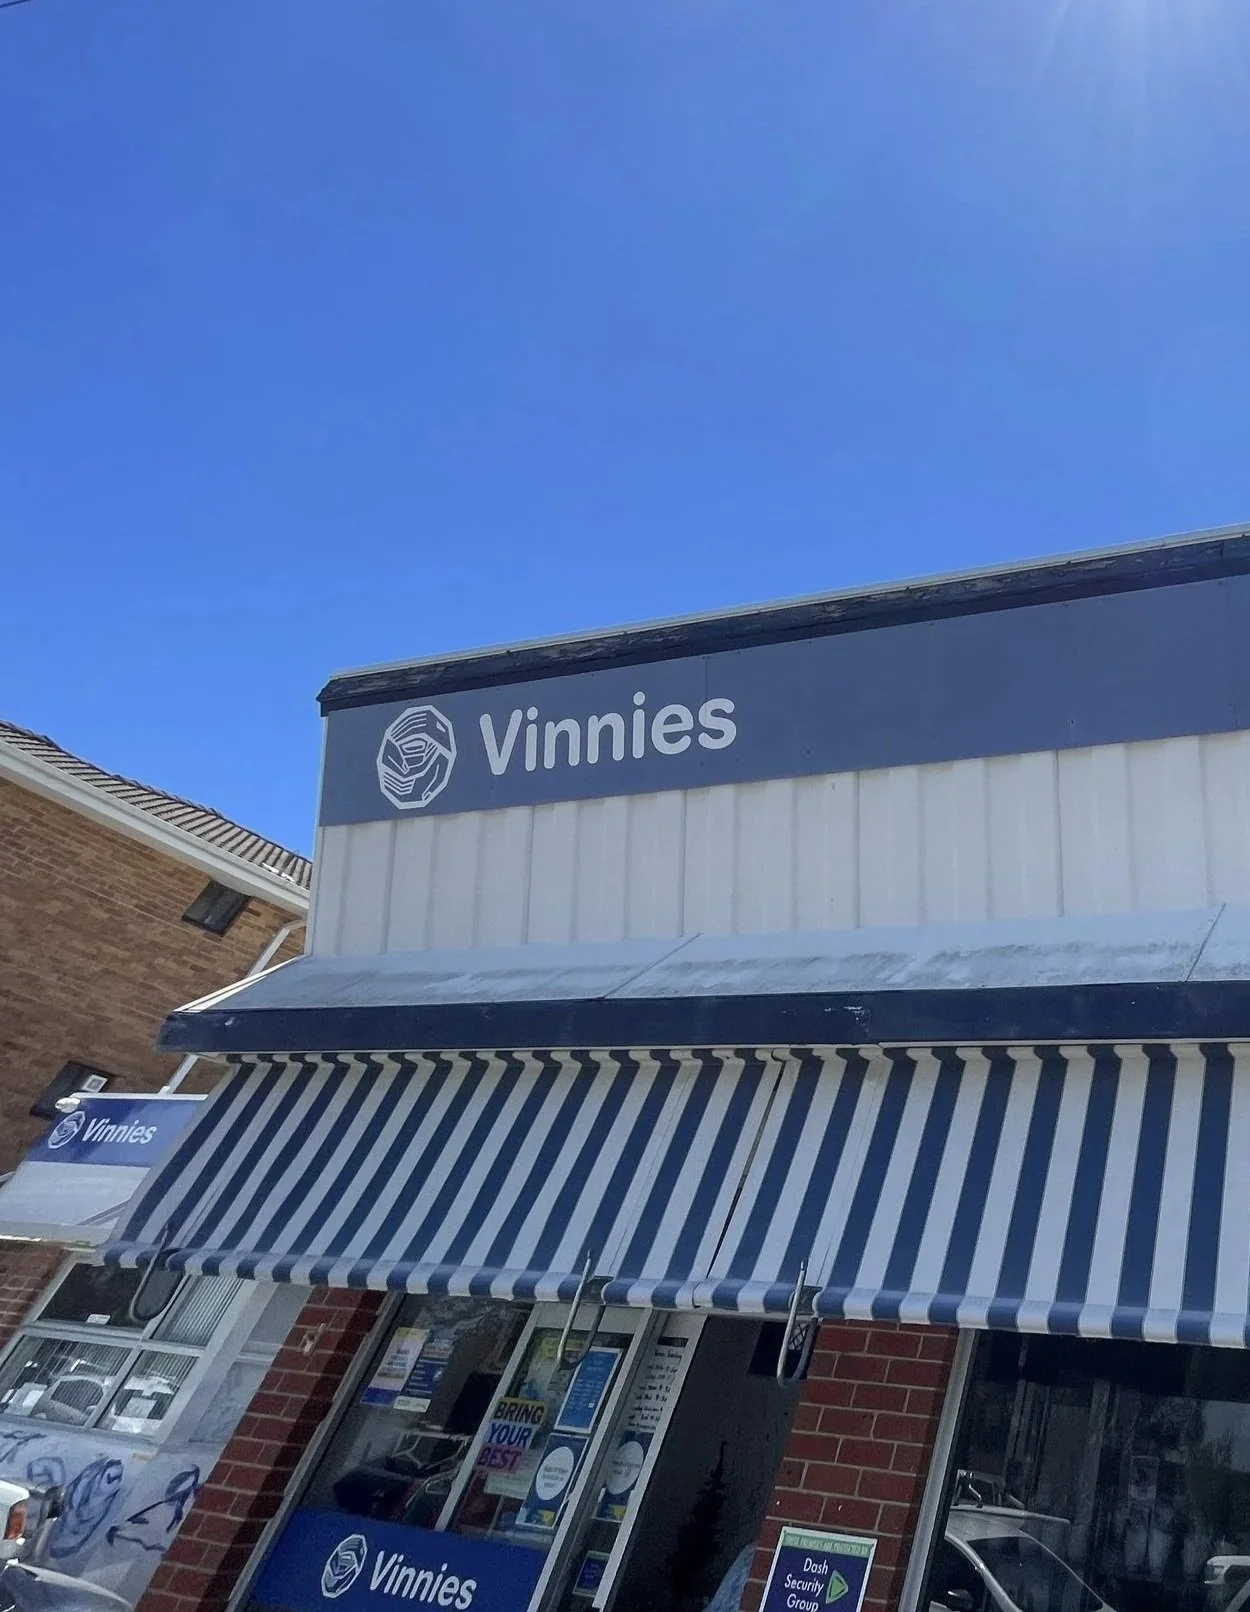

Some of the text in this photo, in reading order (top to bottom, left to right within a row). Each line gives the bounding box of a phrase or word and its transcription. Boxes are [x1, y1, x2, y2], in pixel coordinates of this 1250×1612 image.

[480, 691, 737, 776] Vinnies
[82, 1118, 157, 1144] Vinnies
[494, 1401, 545, 1425] BRING
[488, 1423, 533, 1448] YOUR
[477, 1447, 522, 1471] BEST
[803, 1557, 828, 1575] Dash
[370, 1550, 477, 1610] Vinnies
[784, 1573, 824, 1597] Security
[786, 1593, 819, 1612] Group
